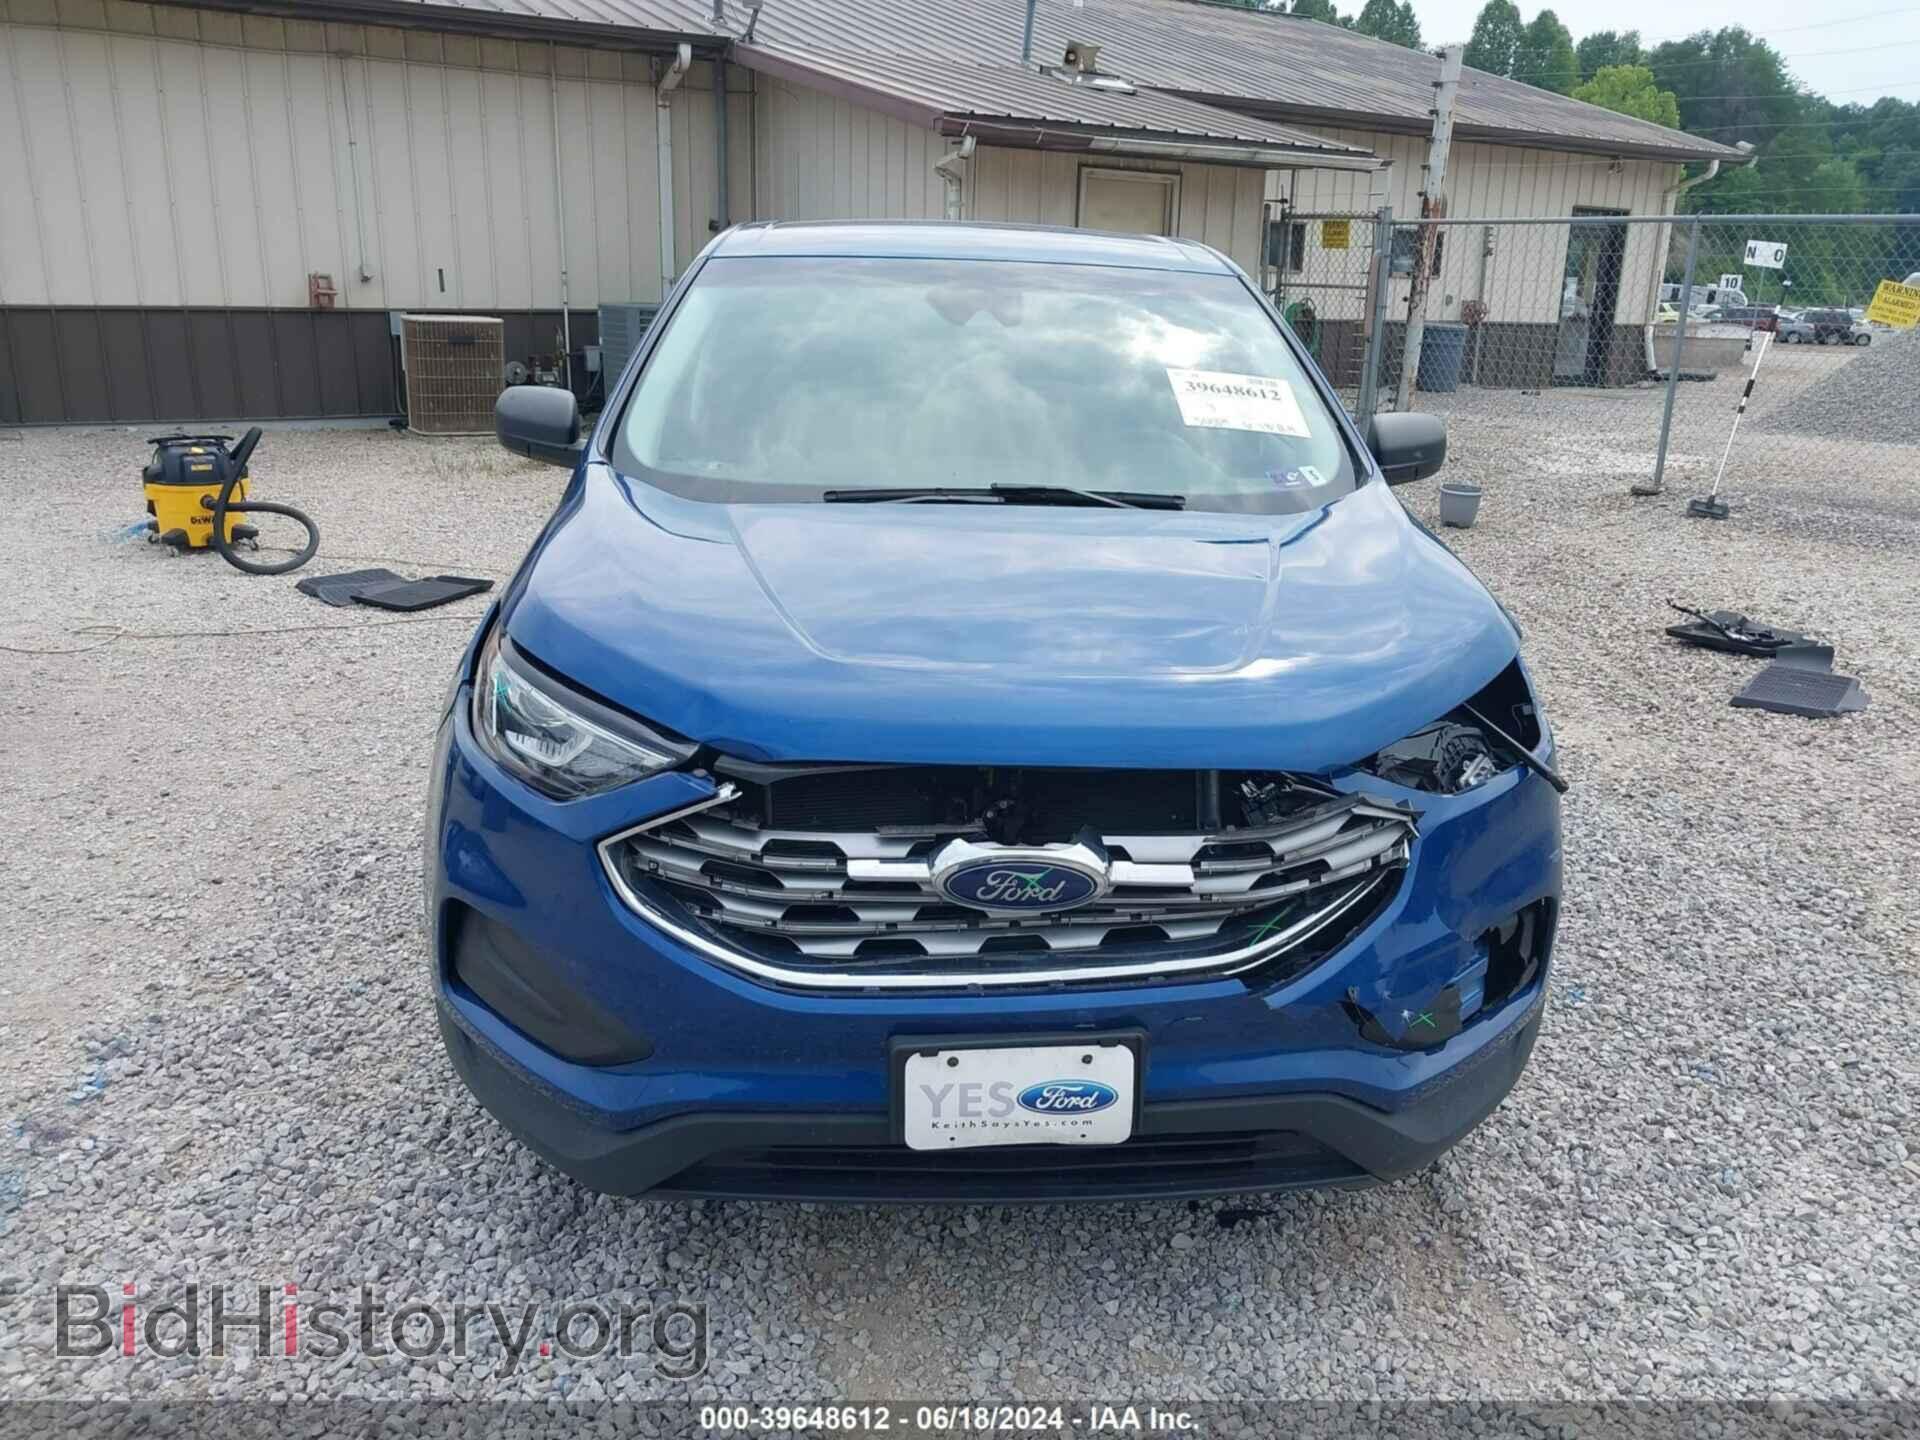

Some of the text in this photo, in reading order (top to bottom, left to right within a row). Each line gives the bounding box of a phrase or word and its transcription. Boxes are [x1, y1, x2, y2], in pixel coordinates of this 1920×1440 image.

[1746, 245, 1757, 259] N
[1725, 276, 1738, 289] 10
[1882, 281, 1920, 297] WARNIN
[1184, 380, 1282, 401] 39648612
[976, 870, 1066, 901] Ford
[919, 1082, 1099, 1119] YES Ford
[931, 1118, 1093, 1130] KeithSaysYes.com
